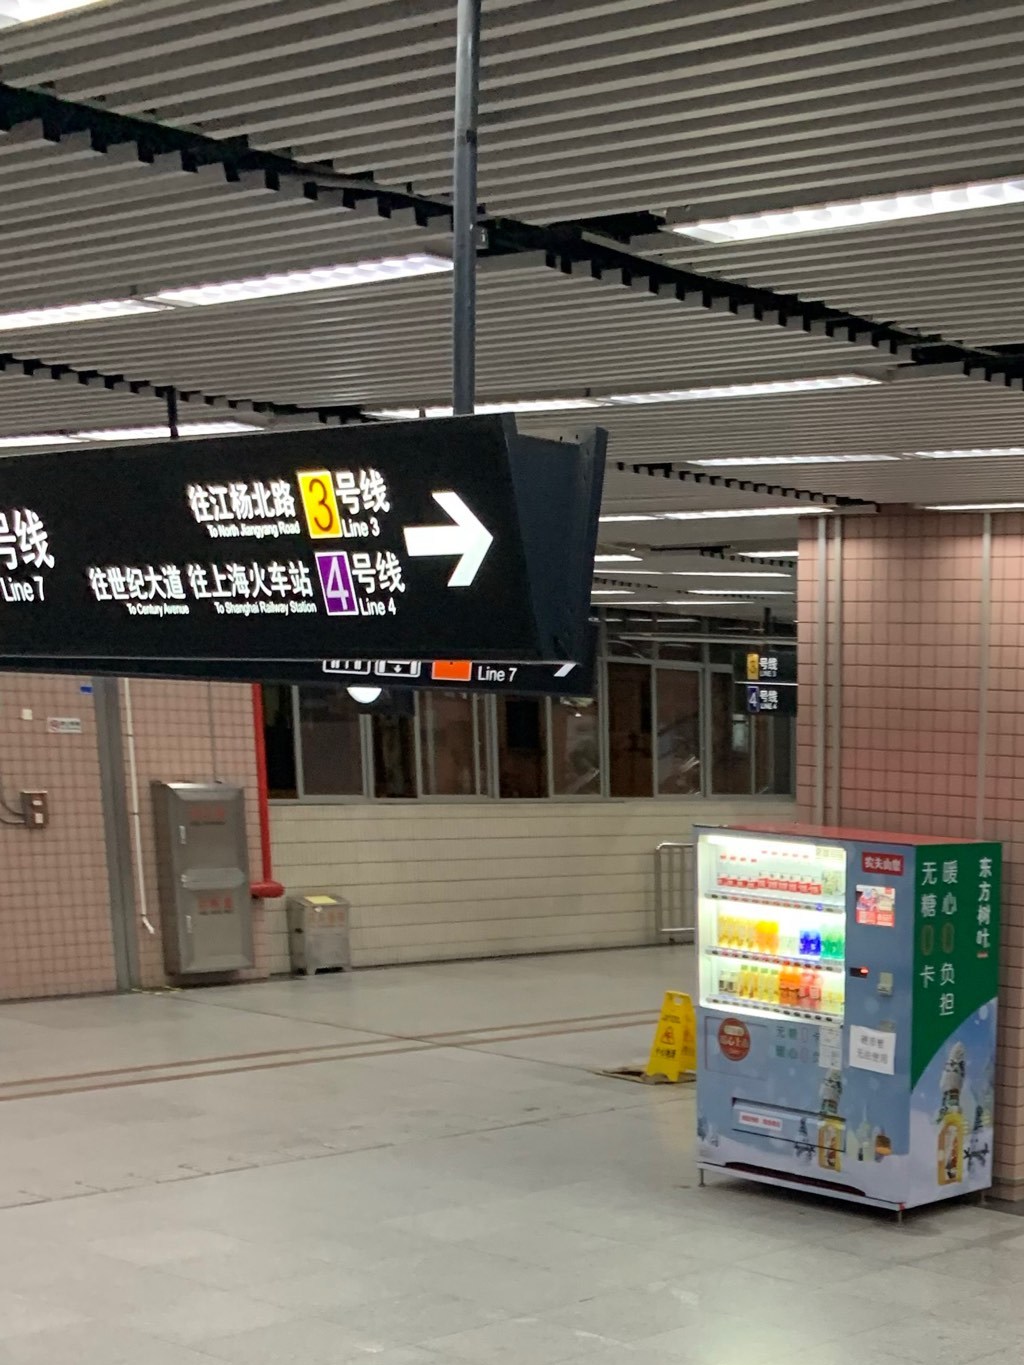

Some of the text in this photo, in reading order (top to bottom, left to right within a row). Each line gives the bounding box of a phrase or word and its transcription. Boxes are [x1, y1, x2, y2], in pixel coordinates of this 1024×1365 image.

[187, 481, 296, 523] 往江杨北路
[207, 520, 300, 539] To North Jiangyang Road
[342, 517, 380, 537] Line 3
[0, 575, 45, 602] Line 7
[88, 564, 187, 601] 往世纪大道
[188, 560, 314, 600] 往上海火车站
[126, 603, 190, 617] To Century Avenue
[213, 600, 317, 616] To Shanghai Railway Station
[359, 597, 397, 615] Line 4
[477, 666, 517, 682] Line 7
[976, 857, 992, 948] 东方树叶
